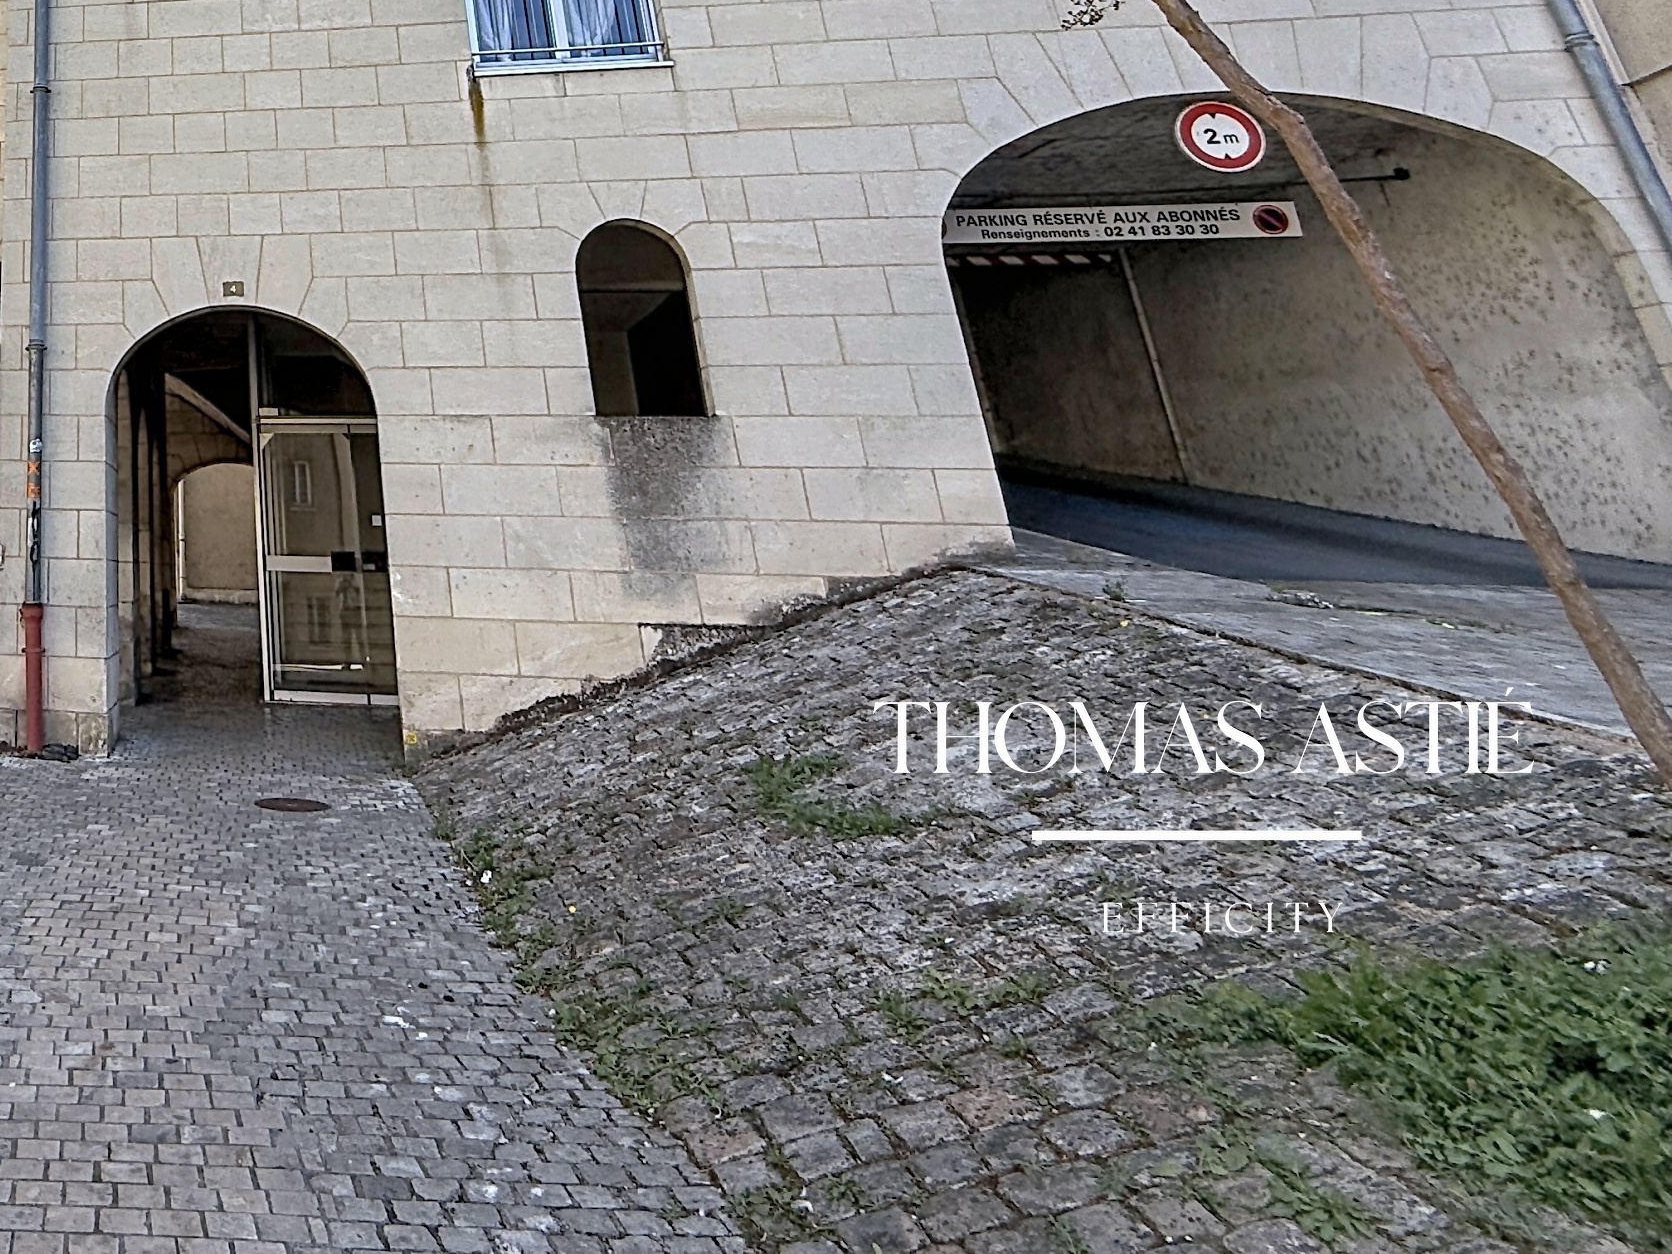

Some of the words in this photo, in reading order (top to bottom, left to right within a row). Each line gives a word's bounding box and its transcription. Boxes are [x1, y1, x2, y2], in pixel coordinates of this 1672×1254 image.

[1203, 128, 1221, 144] 2
[1223, 133, 1240, 144] m
[955, 214, 1028, 227] PARKING
[1032, 209, 1107, 226] RÉSERVÉ
[1113, 211, 1151, 224] AUX
[1156, 206, 1241, 223] ABONNÉS
[980, 228, 1091, 241] Renseignements
[1103, 226, 1124, 237] 02
[1127, 225, 1146, 236] 41
[1151, 225, 1171, 236] 83
[1175, 224, 1195, 235] 30
[1199, 223, 1220, 235] 30
